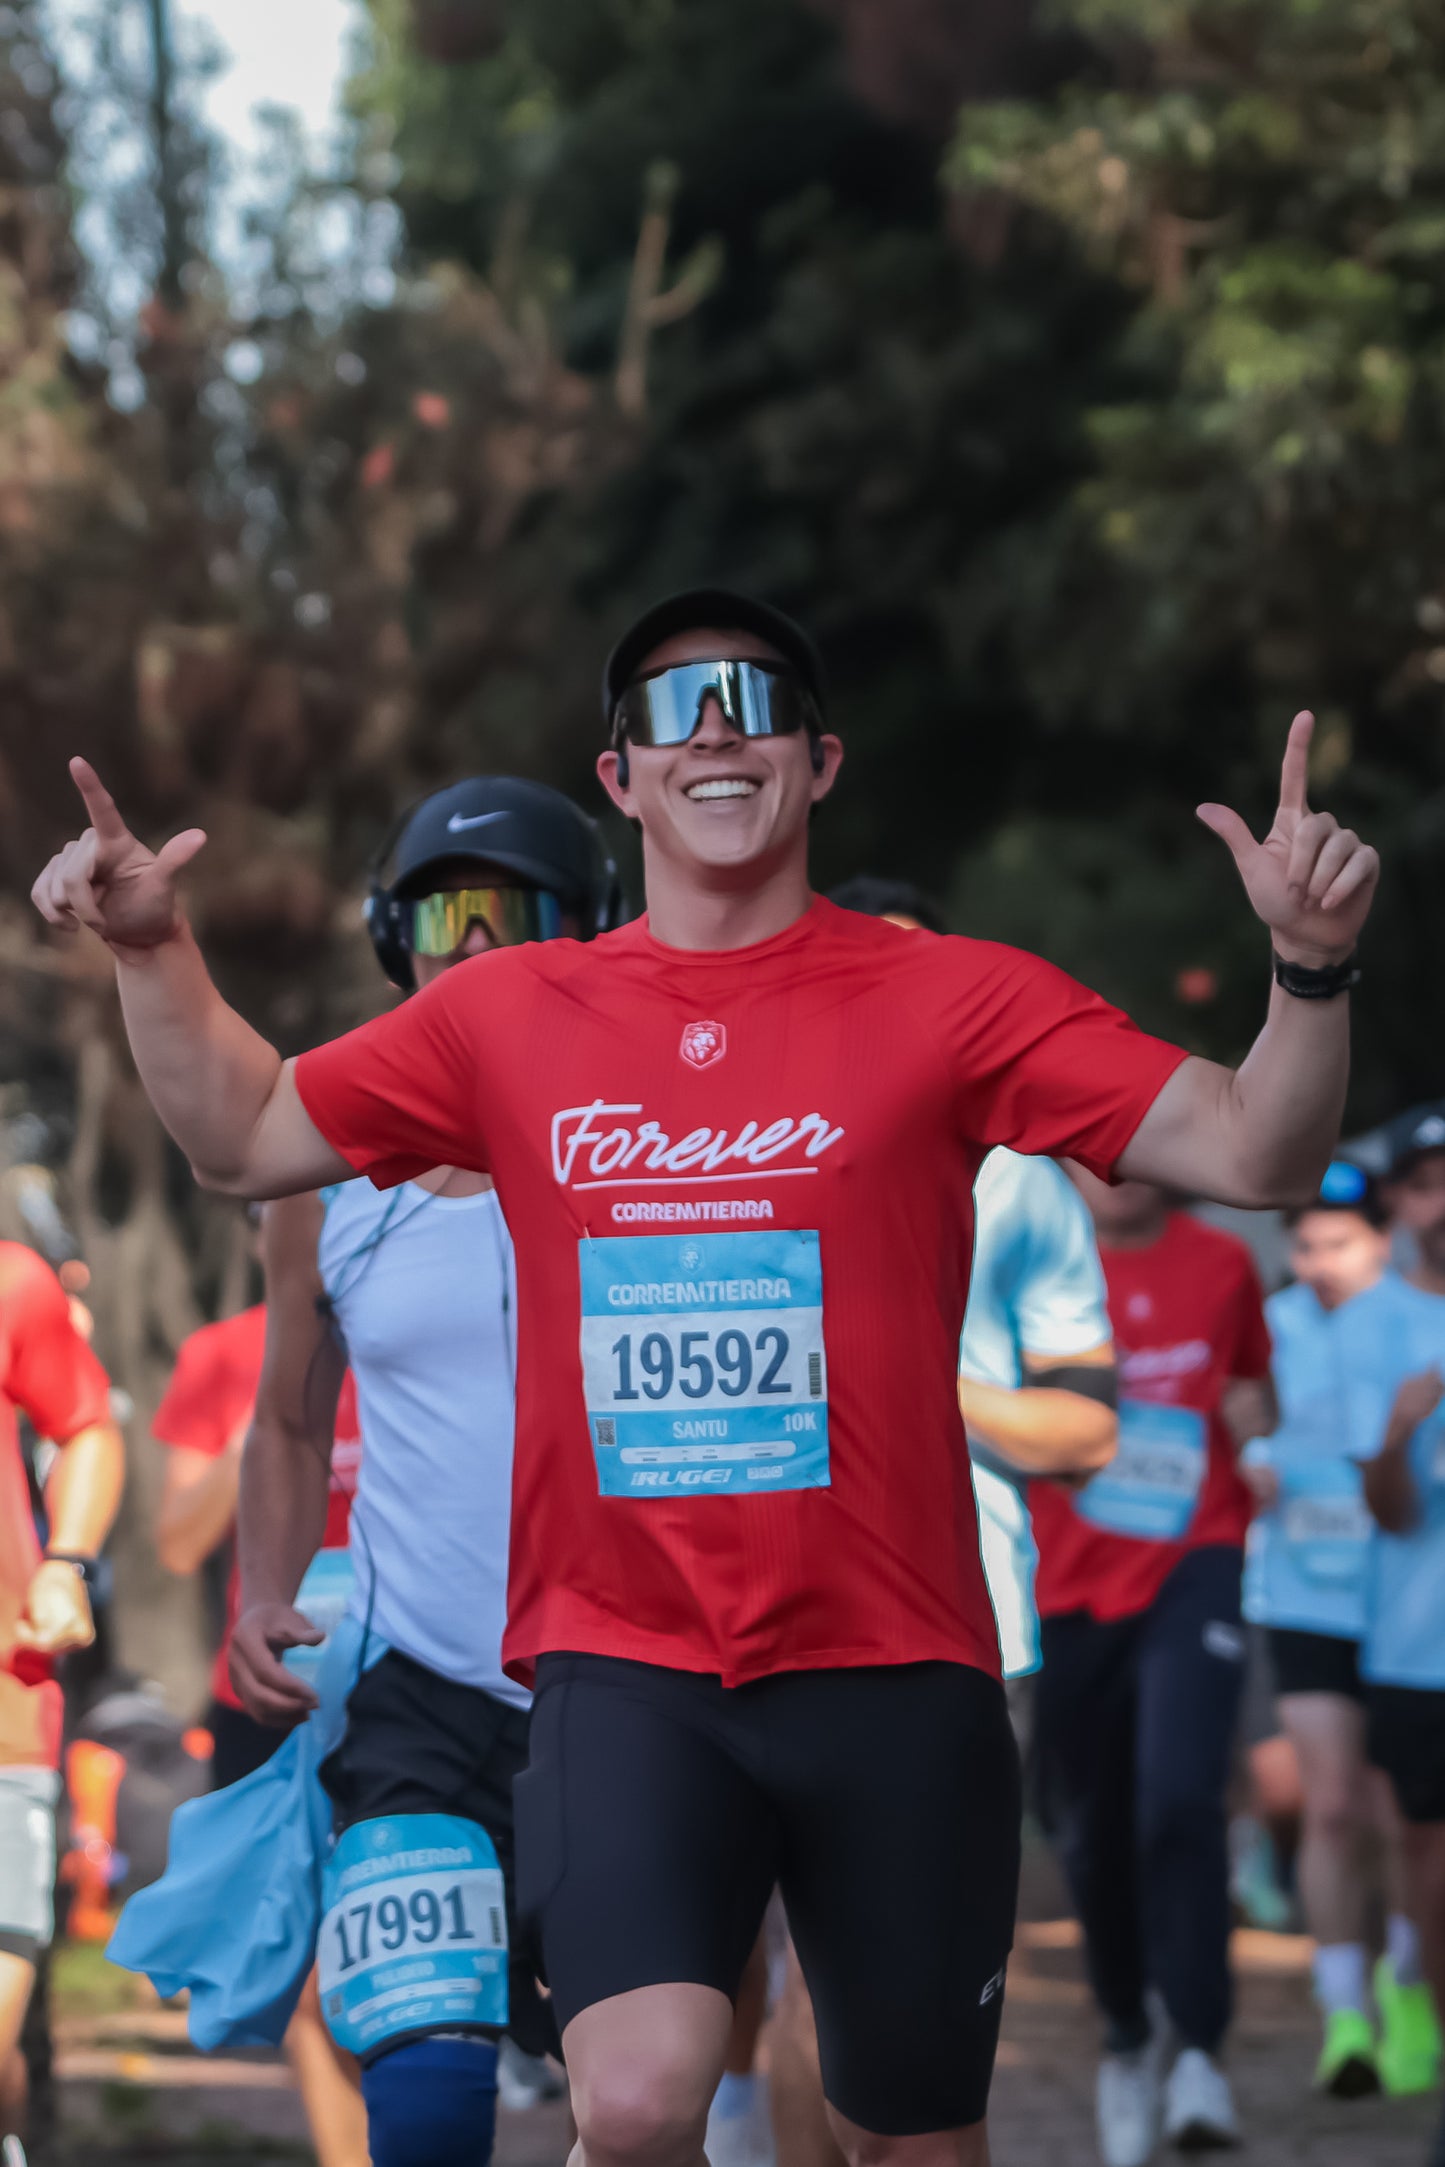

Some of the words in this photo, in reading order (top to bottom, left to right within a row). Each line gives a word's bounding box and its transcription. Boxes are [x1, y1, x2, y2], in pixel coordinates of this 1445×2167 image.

[551, 1098, 845, 1185] Forever
[611, 1326, 792, 1401] 19592
[672, 1419, 728, 1440] SANTU
[783, 1411, 817, 1433] 10K
[335, 1886, 474, 1971] 17991
